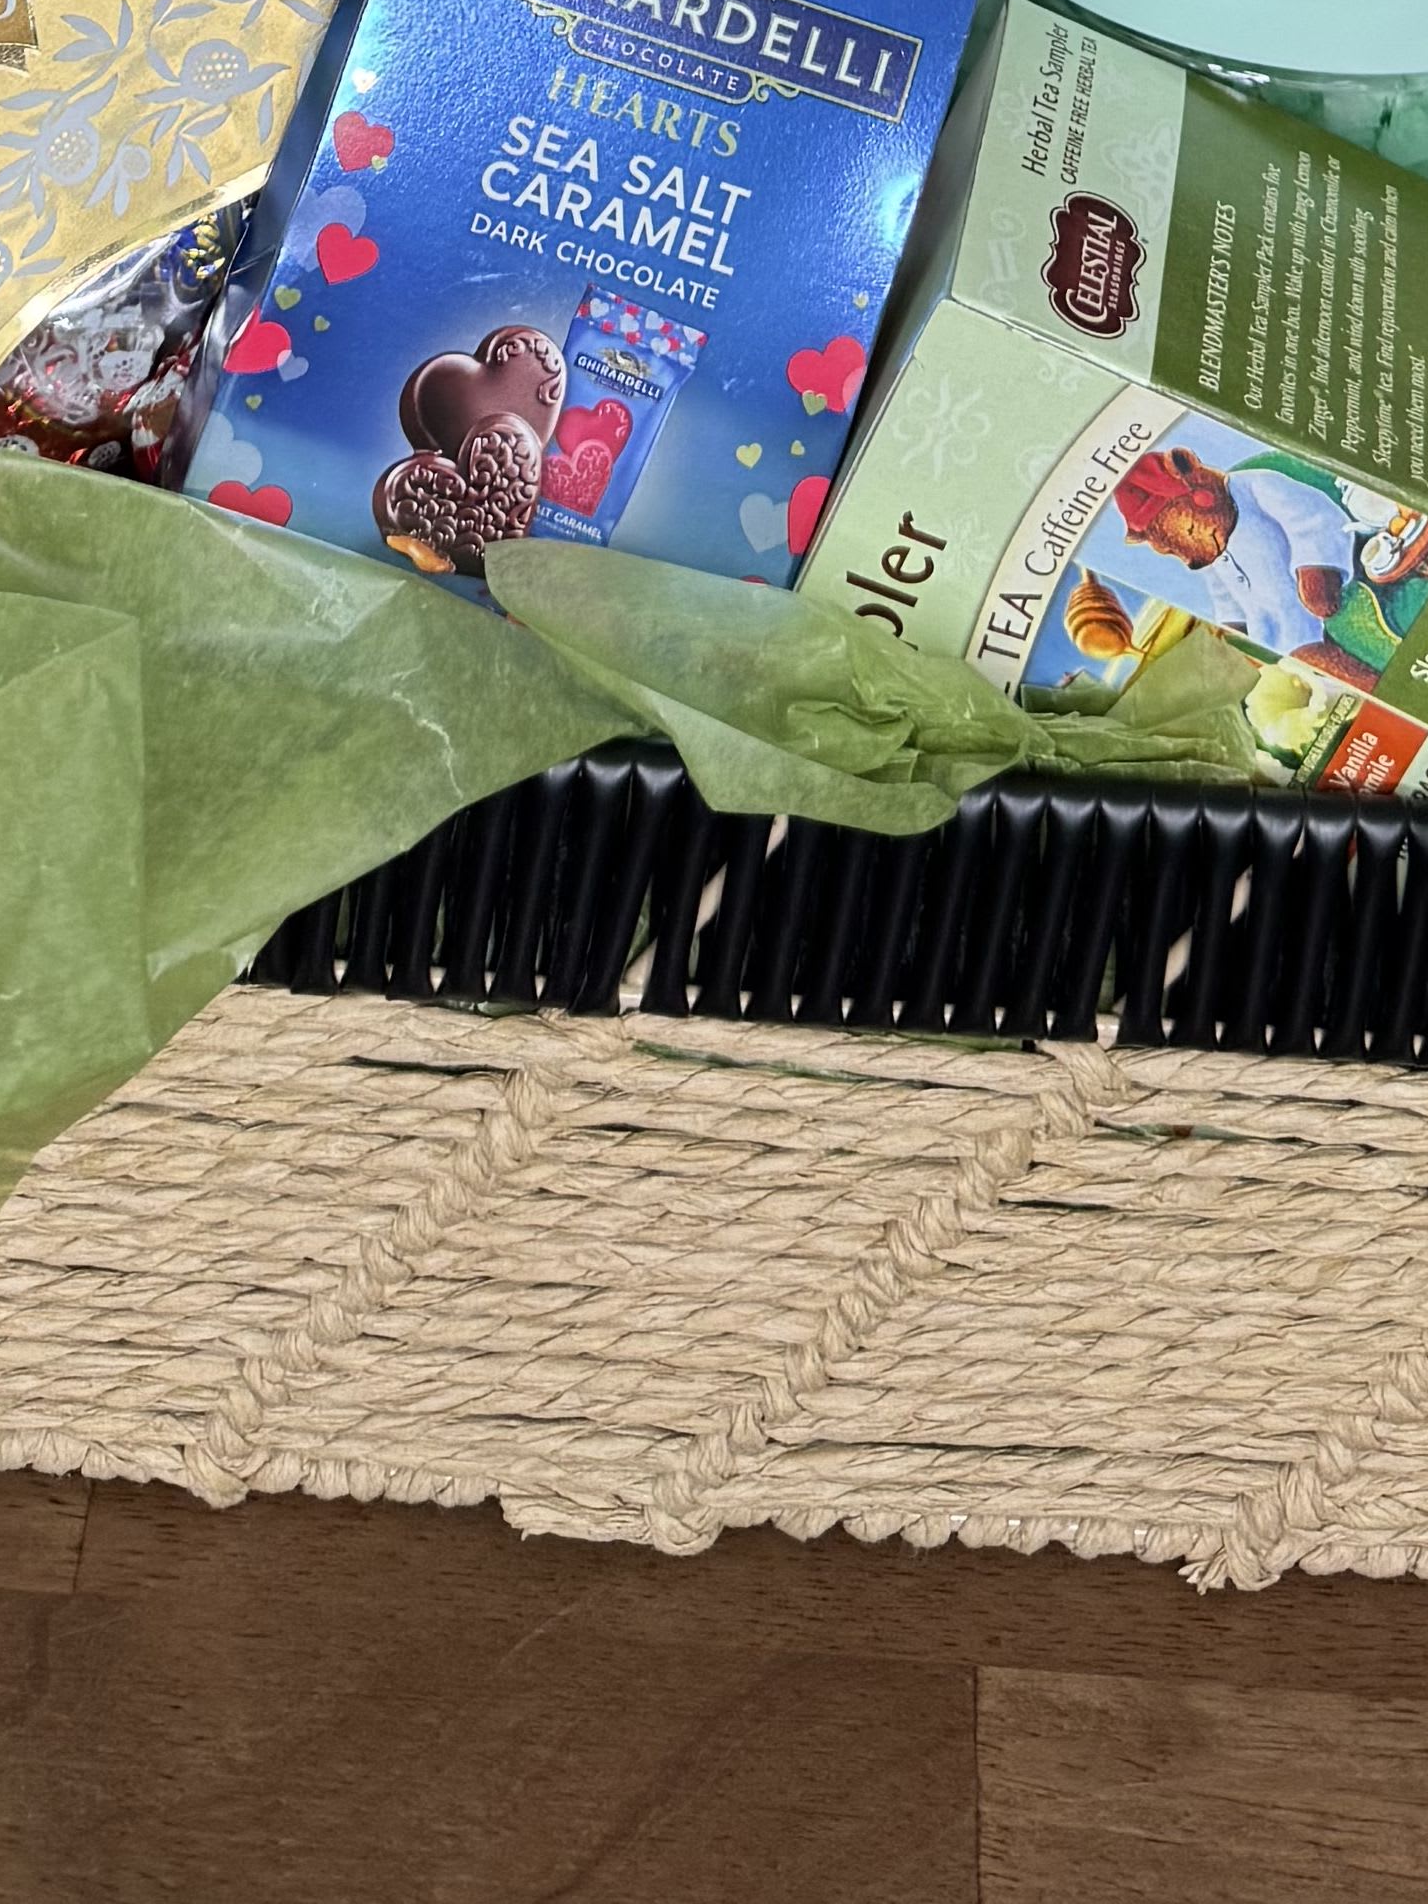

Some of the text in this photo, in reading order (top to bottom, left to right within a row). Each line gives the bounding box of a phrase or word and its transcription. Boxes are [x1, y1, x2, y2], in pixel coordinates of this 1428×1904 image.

[582, 28, 741, 92] CHOCOLATE
[548, 65, 743, 158] HEARTS
[1022, 21, 1074, 176] Herbal Tea Sampler
[1060, 36, 1097, 185] CAFFEINE FREE HERBAL TEA
[500, 116, 753, 226] SEA SALT
[1327, 154, 1341, 171] or
[481, 160, 735, 277] CARAMEL
[1262, 186, 1279, 234] contains
[1293, 191, 1315, 221] tangy
[1320, 173, 1339, 234] Chamomile
[1381, 184, 1398, 215] when
[1255, 236, 1275, 263] Pack
[1288, 221, 1307, 248] with
[1320, 235, 1336, 250] in
[1350, 208, 1374, 256] soothing
[1380, 215, 1398, 243] calm
[471, 212, 721, 310] DARK CHOCOLATE
[1065, 210, 1118, 324] CELESTIAL
[1291, 247, 1311, 265] up
[1317, 249, 1336, 298] comfort
[1348, 256, 1366, 284] with
[1379, 239, 1397, 267] and
[1107, 240, 1126, 312] SEASONINGS
[1199, 200, 1236, 390] BLENDMASTER'S NOTES
[1251, 266, 1276, 314] Sampler
[1347, 284, 1365, 317] down
[1380, 266, 1399, 336] rejuvenation
[1249, 317, 1269, 336] Tea
[1285, 329, 1300, 355] one
[1311, 298, 1333, 358] afternoon
[1340, 314, 1364, 347] wind
[1246, 337, 1266, 383] Herbal
[1280, 355, 1297, 370] in
[1309, 355, 1330, 384] find
[1343, 345, 1363, 375] and
[1375, 335, 1395, 368] Find
[576, 354, 662, 400] GHIRARDELLI
[1243, 383, 1263, 409] Our
[1275, 374, 1297, 424] favorites
[1406, 389, 1425, 423] them
[1405, 419, 1425, 455] need
[554, 511, 603, 540] CARAMEL
[977, 422, 1152, 659] TEA Caffeine Free
[1329, 730, 1379, 790] Vanilla
